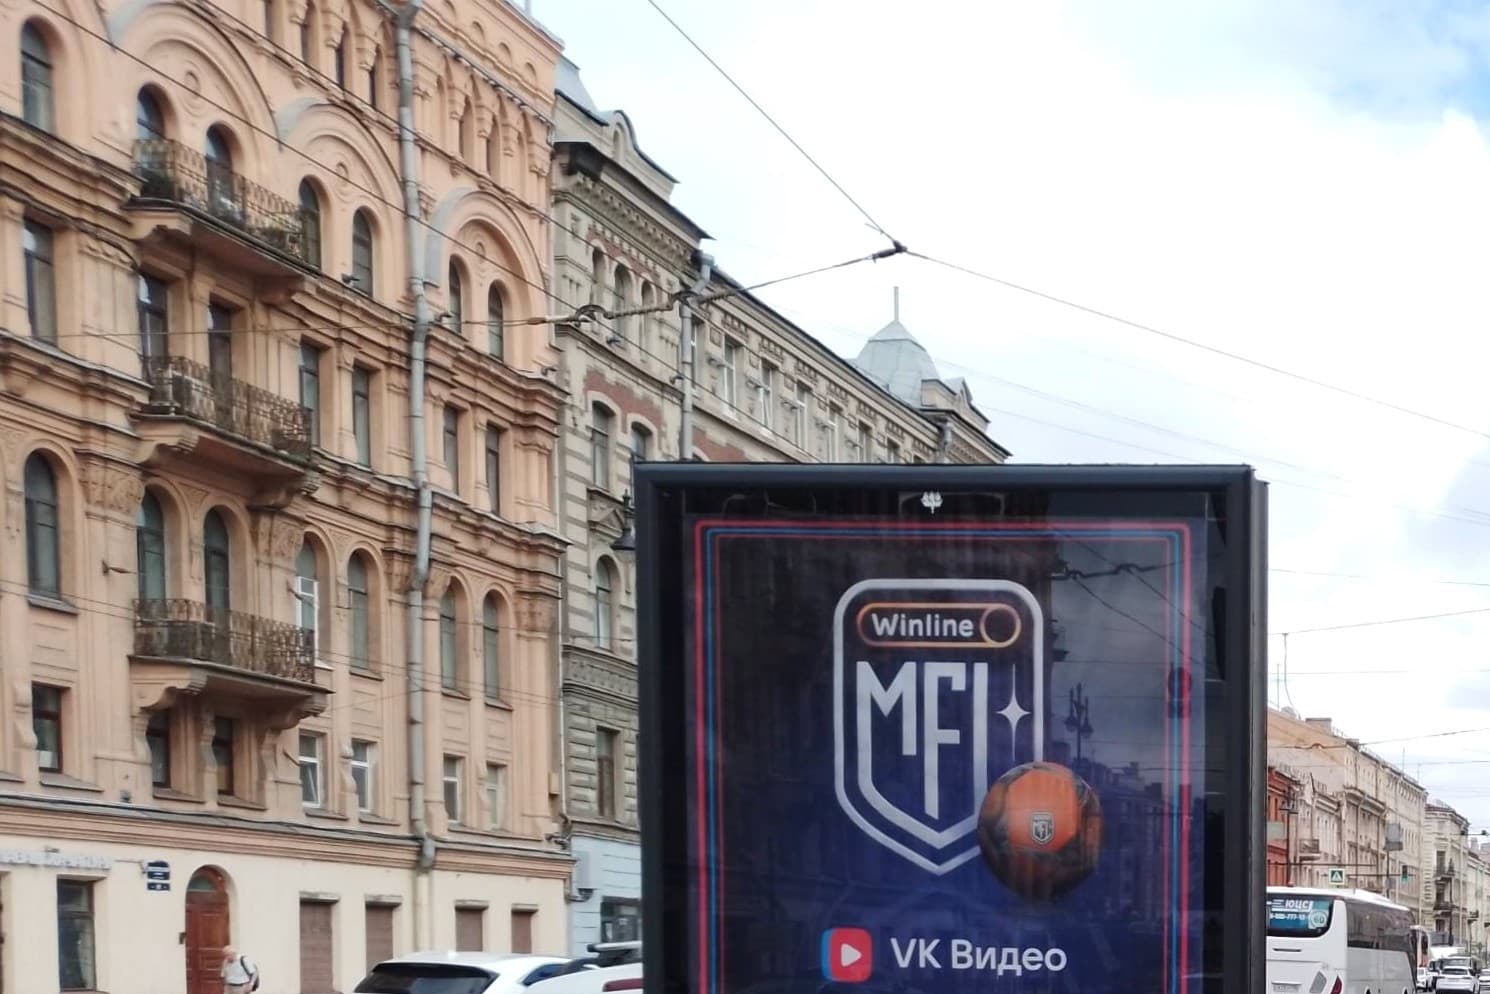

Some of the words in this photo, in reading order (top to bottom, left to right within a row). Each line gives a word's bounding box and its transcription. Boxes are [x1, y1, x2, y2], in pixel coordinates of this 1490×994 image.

[871, 613, 975, 637] Winline
[890, 938, 941, 969] VK
[951, 939, 1068, 976] Видео
